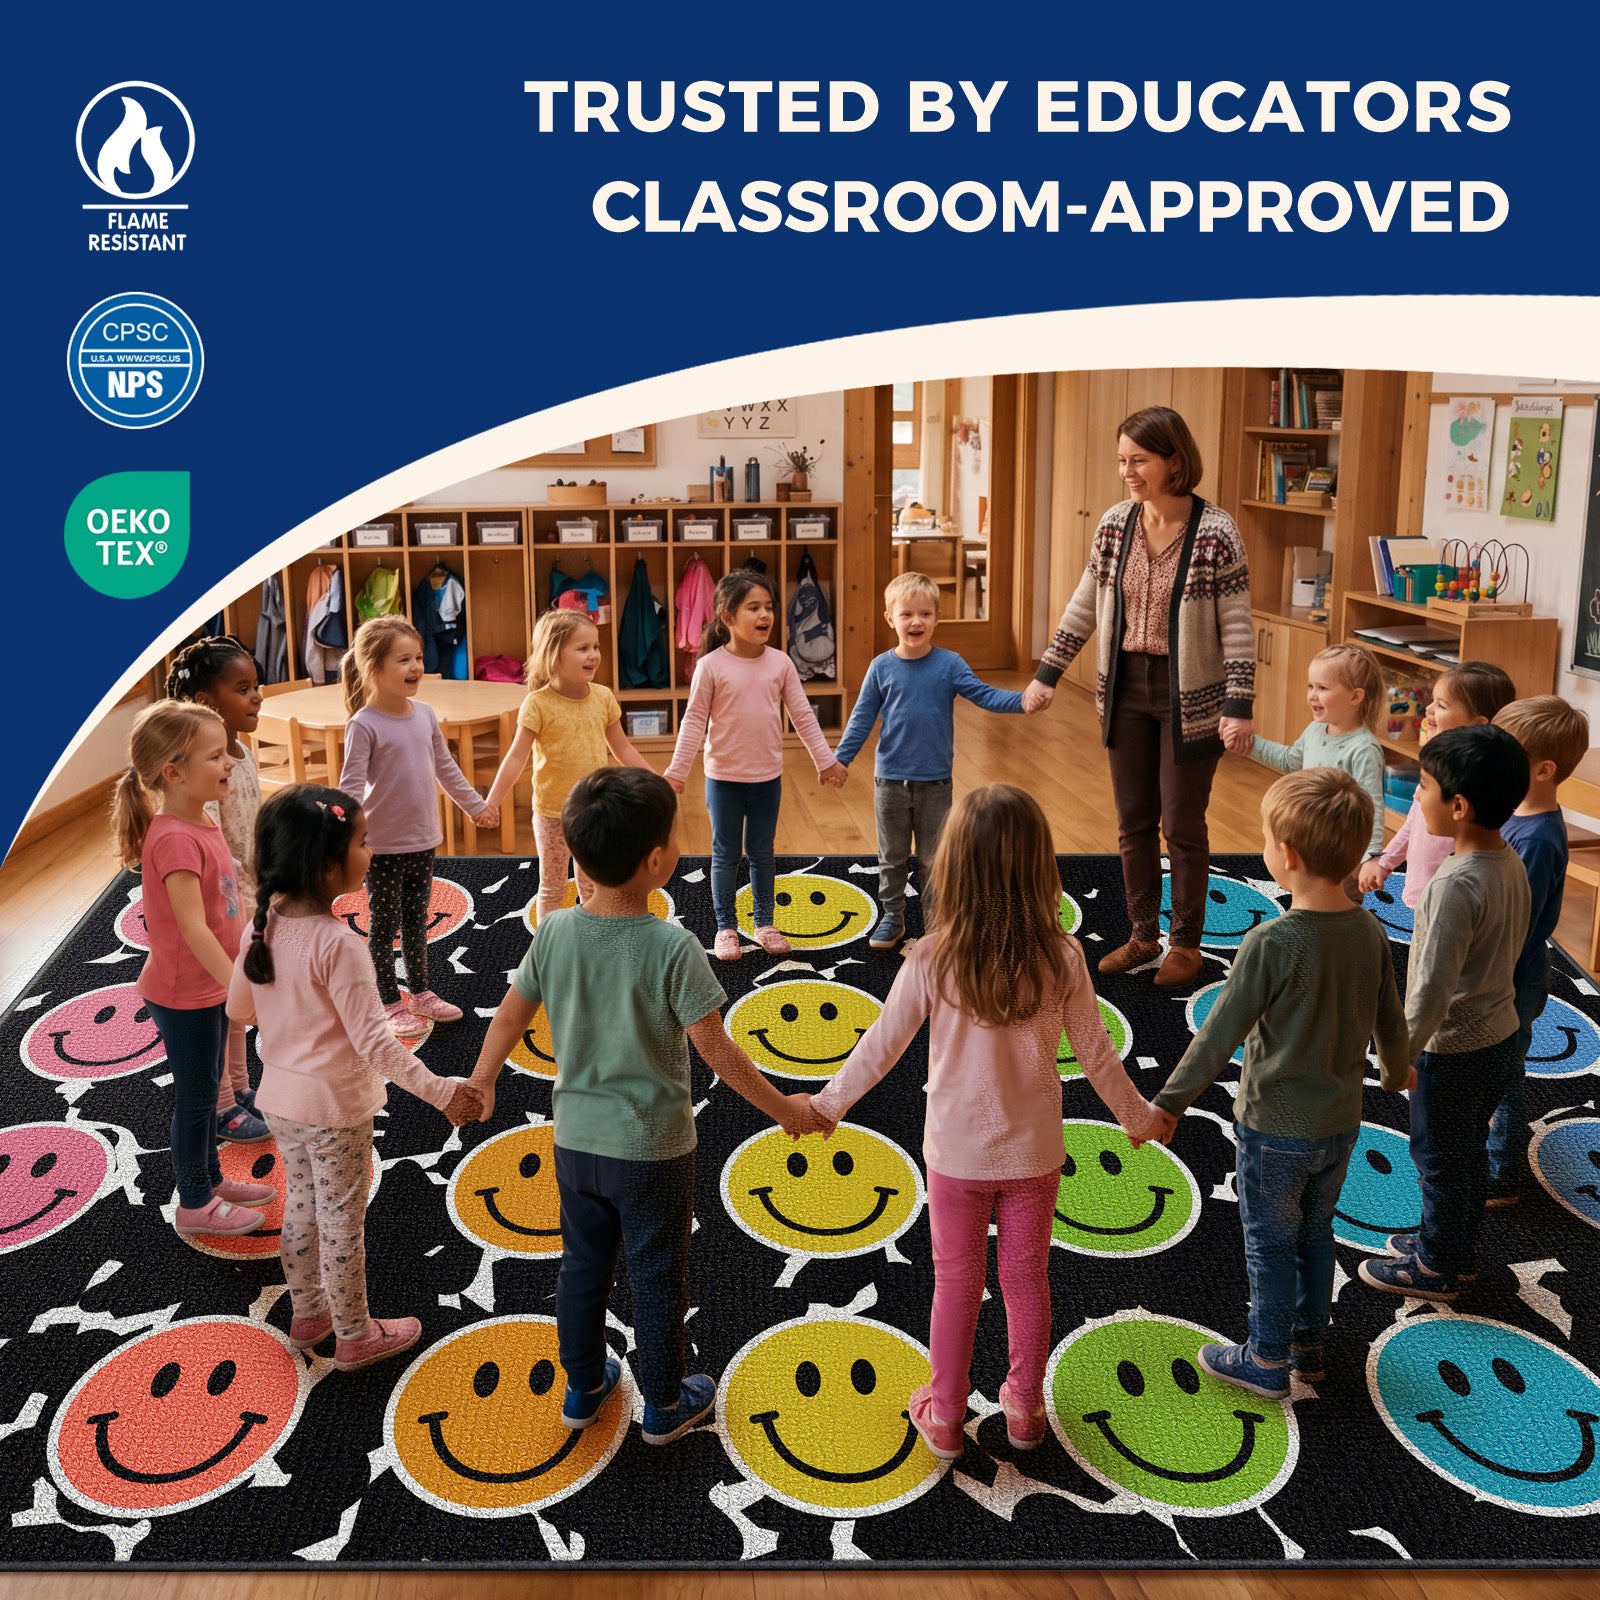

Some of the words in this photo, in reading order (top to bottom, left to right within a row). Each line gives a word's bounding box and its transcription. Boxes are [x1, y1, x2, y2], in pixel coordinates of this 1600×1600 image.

[777, 399, 788, 412] X
[724, 416, 735, 430] Y
[742, 416, 753, 430] Y
[759, 416, 770, 430] Z
